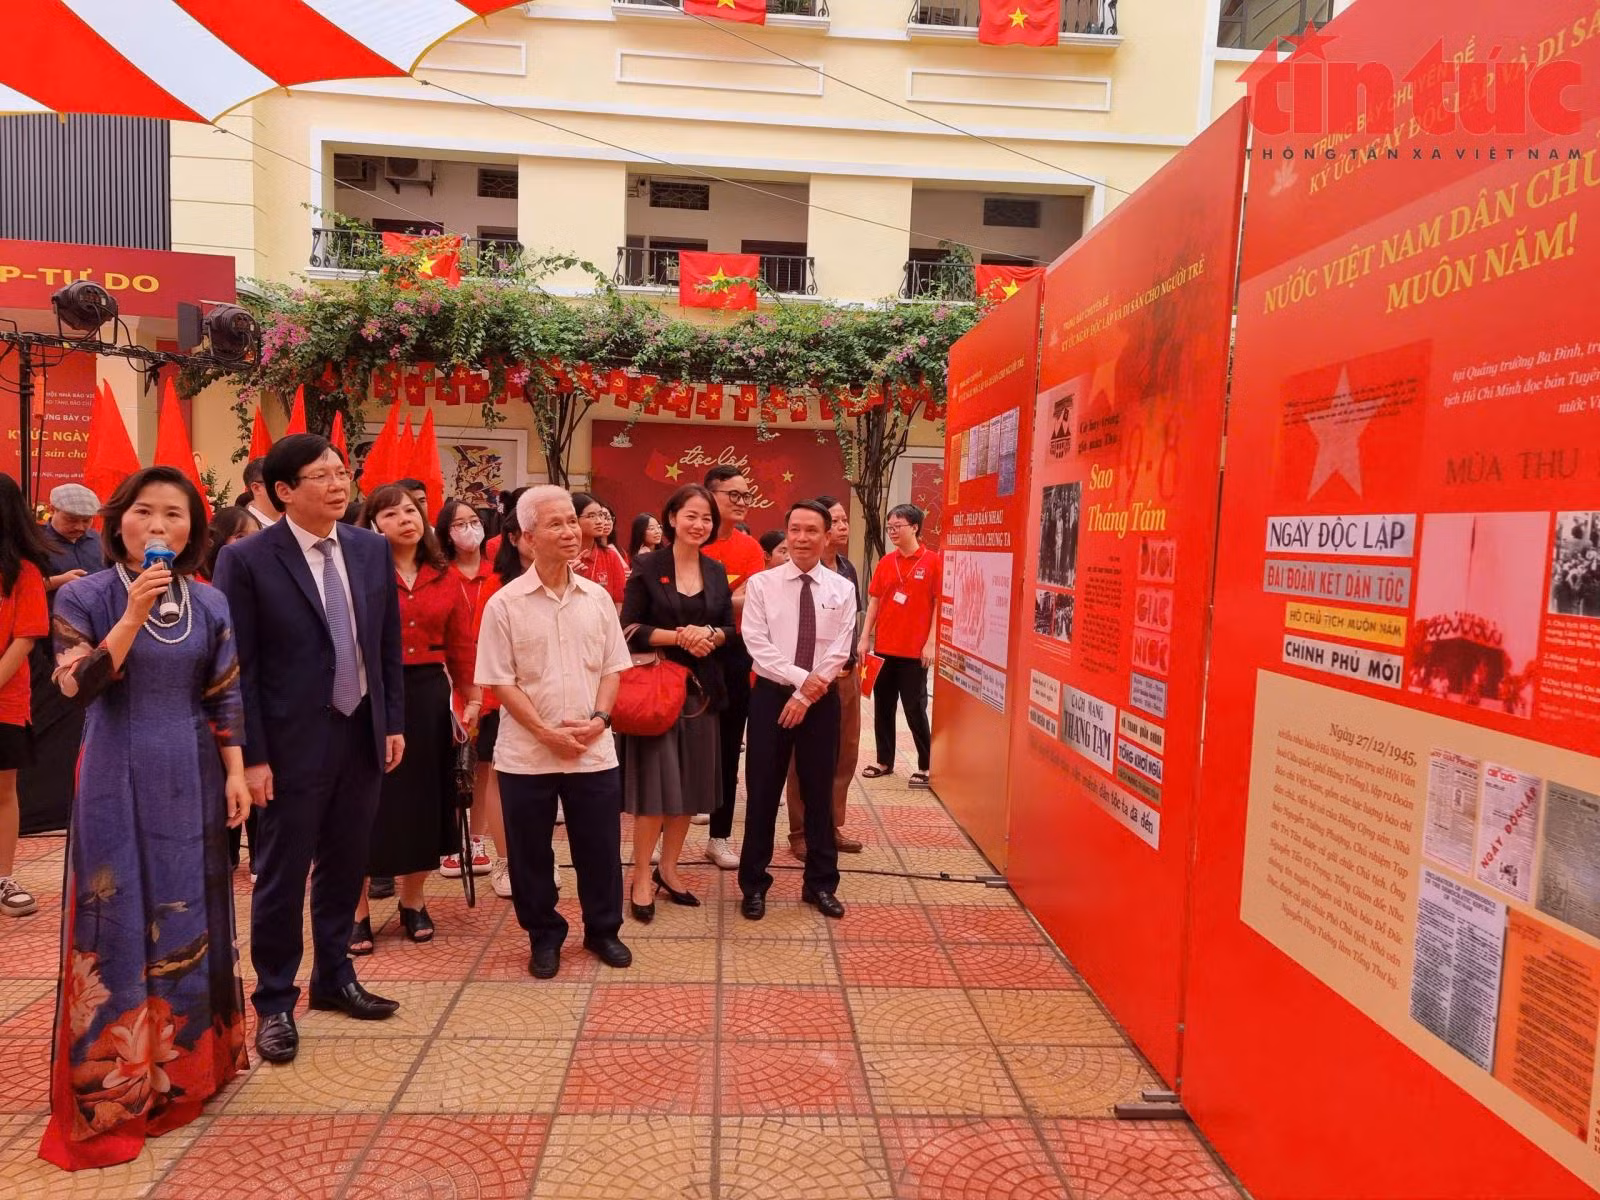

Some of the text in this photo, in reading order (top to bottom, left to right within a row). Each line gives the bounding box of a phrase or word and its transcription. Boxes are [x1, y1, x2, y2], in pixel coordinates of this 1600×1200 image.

[1263, 263, 1318, 315] NƯỚC
[1321, 243, 1376, 290] VIỆT
[1379, 214, 1444, 269] NAM
[1448, 183, 1520, 242] DÂN
[1386, 211, 1578, 314] MUÔN NĂM!
[104, 272, 160, 293] DO
[53, 429, 90, 442] NGÀY
[68, 449, 88, 459] cho
[1089, 463, 1114, 490] Sao
[1087, 499, 1167, 540] Tháng Tám
[1269, 515, 1405, 552] NGÀY ĐỘC LẬP
[1285, 638, 1401, 685] CHÍNH PHỦ MỚI
[1328, 722, 1418, 770] Ngày 27/12/1945,
[1392, 789, 1414, 813] Đoàn
